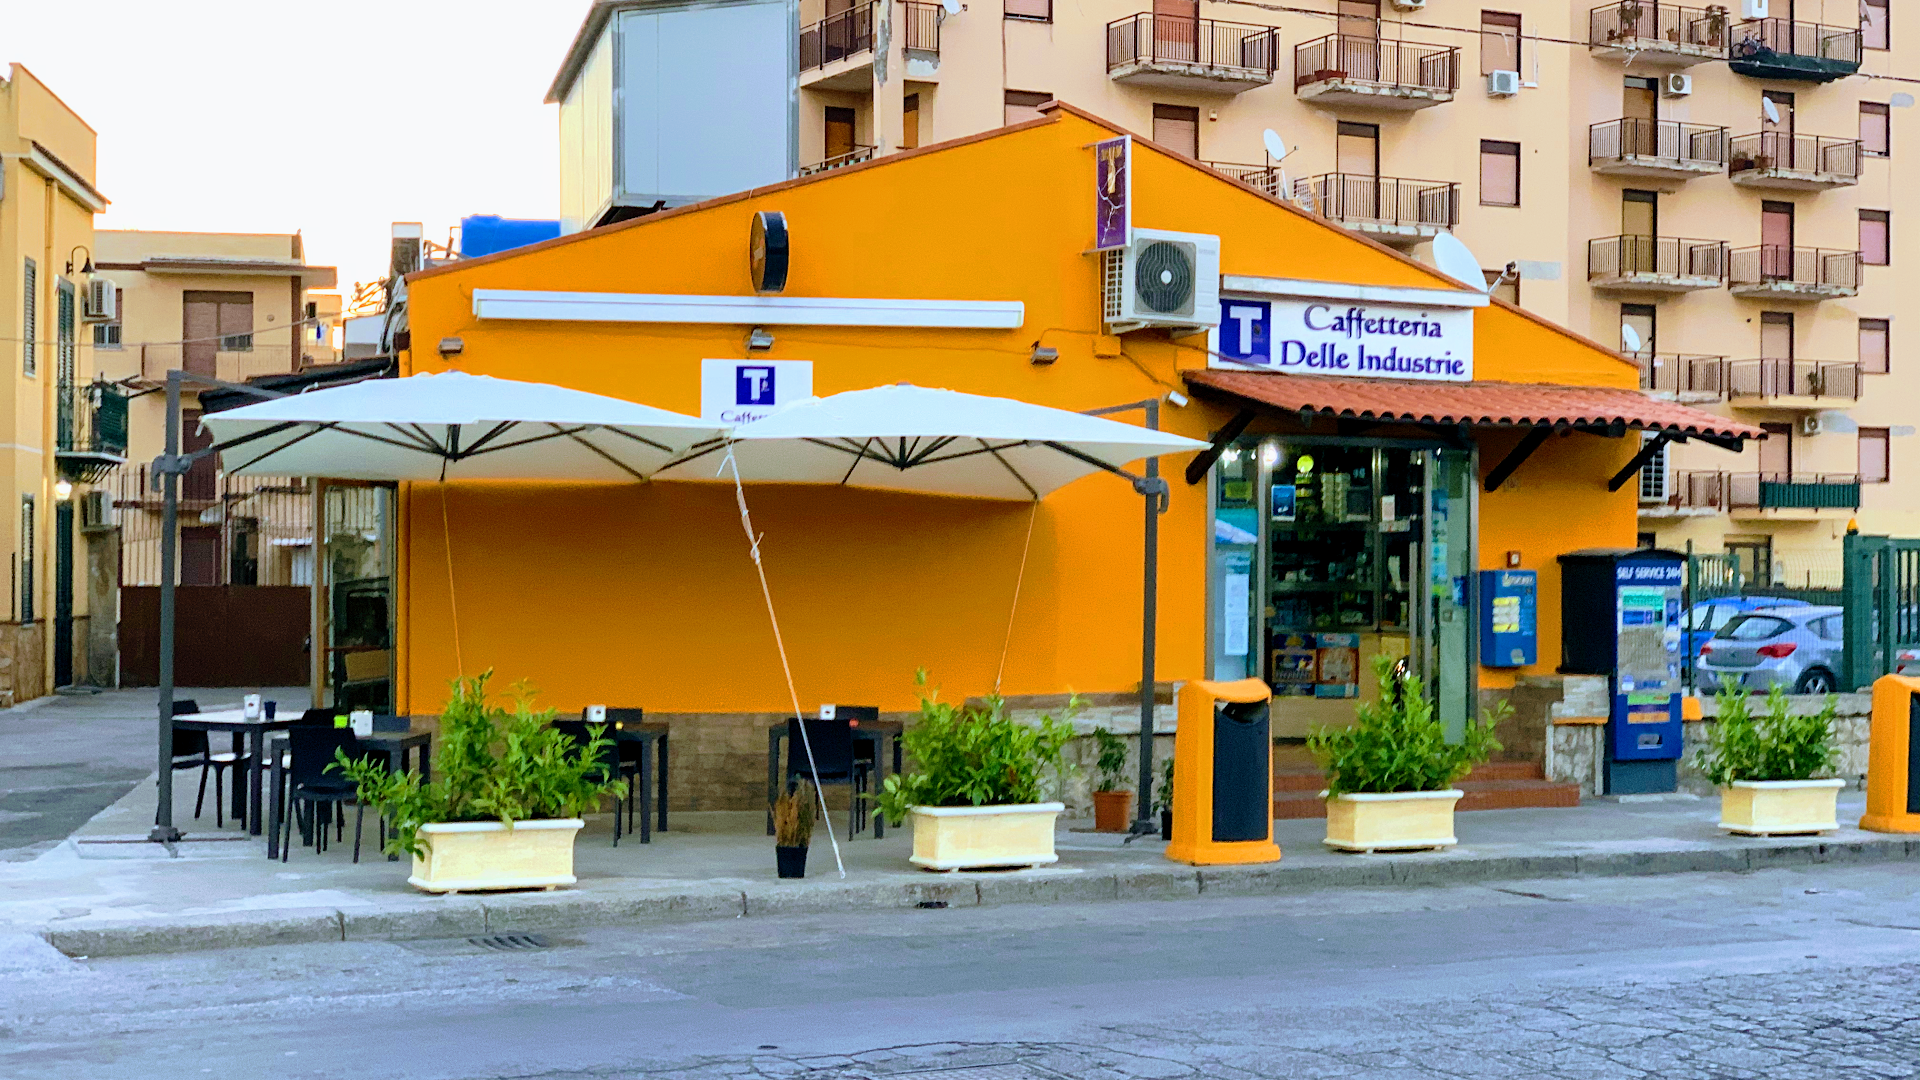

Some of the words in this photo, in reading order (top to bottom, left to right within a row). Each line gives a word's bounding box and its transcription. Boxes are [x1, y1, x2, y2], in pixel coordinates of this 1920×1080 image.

[1229, 305, 1263, 355] T
[1303, 304, 1443, 339] Caffetteria
[1280, 339, 1350, 370] Delle
[1358, 343, 1465, 376] Industrie
[742, 368, 769, 401] T
[1616, 566, 1634, 580] SELF
[1635, 566, 1665, 580] SERVICE
